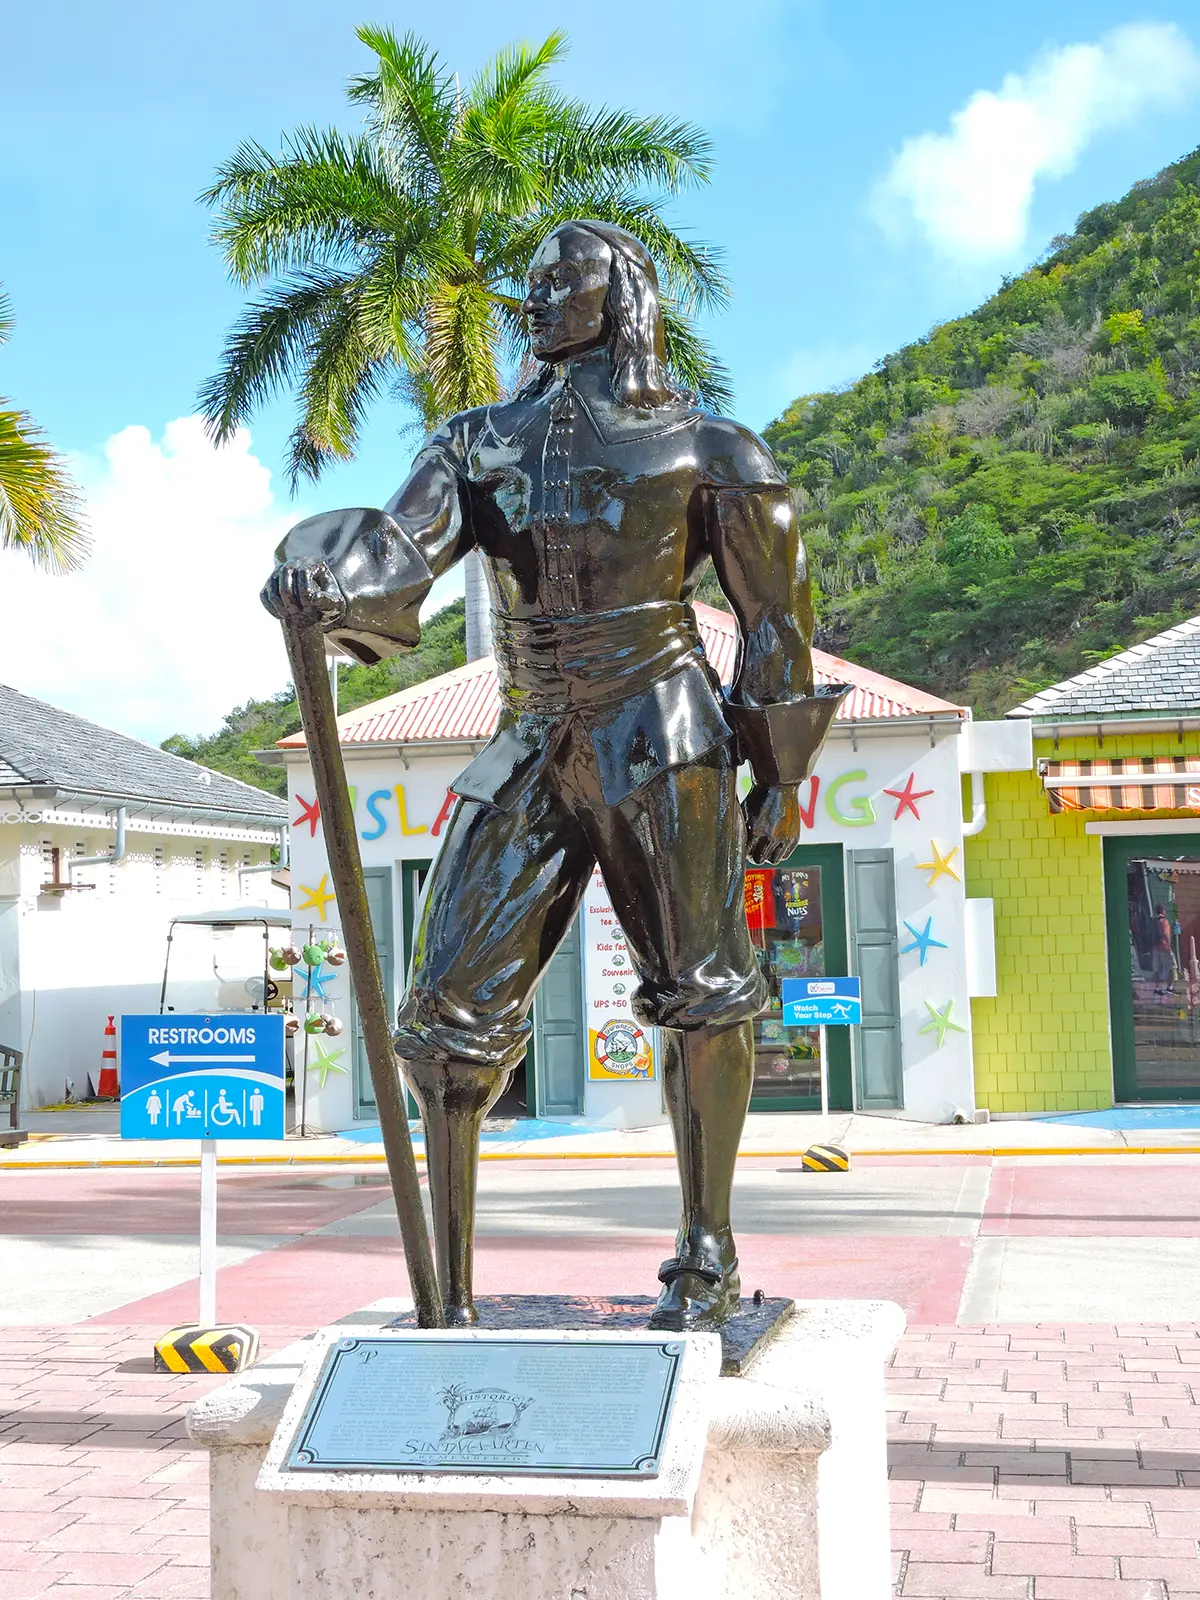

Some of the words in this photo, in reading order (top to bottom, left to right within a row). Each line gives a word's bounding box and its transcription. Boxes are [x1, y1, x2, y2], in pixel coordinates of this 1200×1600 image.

[787, 906, 808, 916] NUTS
[600, 918, 612, 926] tee
[596, 943, 613, 952] Kids
[594, 1000, 609, 1009] UPS
[793, 1004, 818, 1012] Watch
[814, 1011, 832, 1020] Step
[604, 1024, 636, 1035] SHIPWRECK
[148, 1027, 256, 1045] RESTROOMS
[459, 1393, 521, 1403] HISTORIC
